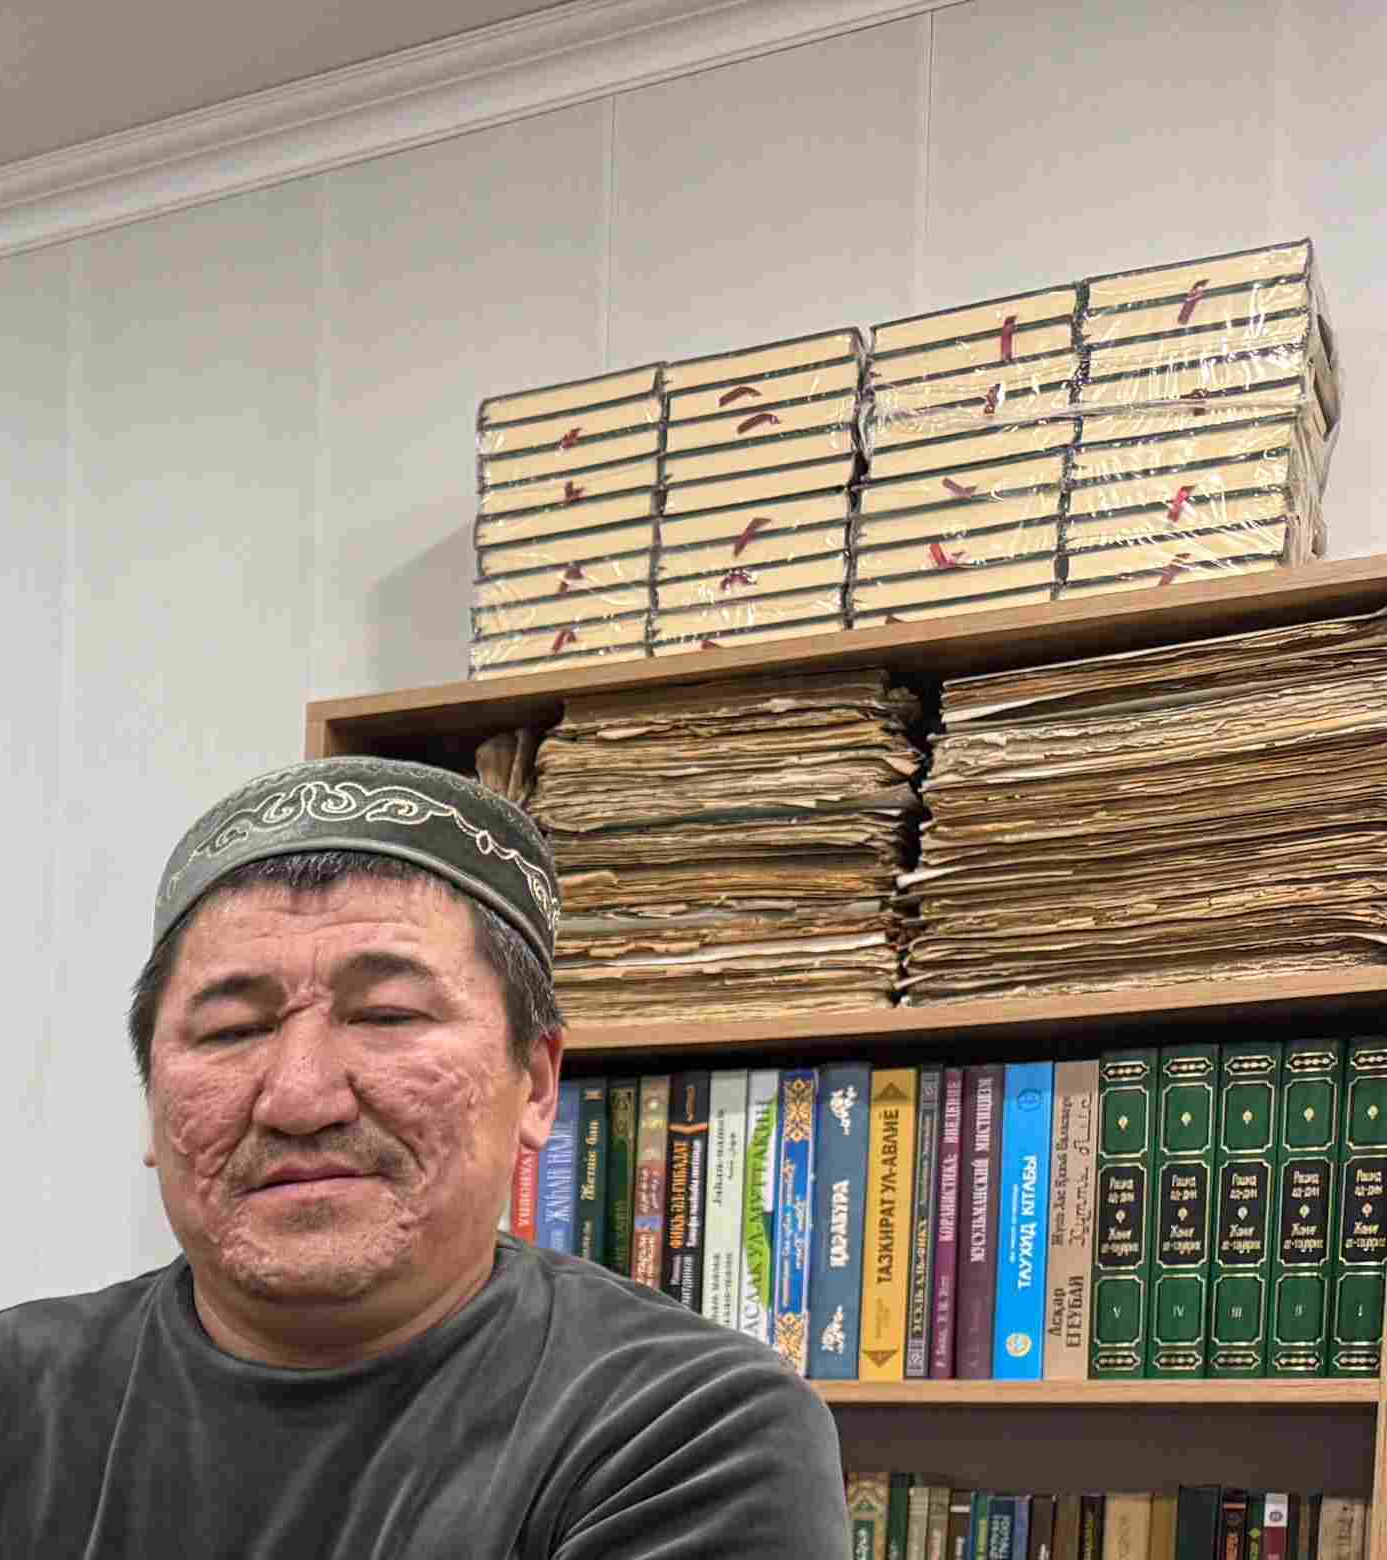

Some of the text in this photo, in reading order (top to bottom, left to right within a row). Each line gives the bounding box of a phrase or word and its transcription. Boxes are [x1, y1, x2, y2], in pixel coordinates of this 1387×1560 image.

[969, 1076, 995, 1263] МУСУЛЬМАНСКИЙ МИСТИЦИЗМ
[1016, 1154, 1037, 1290] ТАУХИД КІТАБЫ
[876, 1198, 898, 1286] ТАЗКИРАТ
